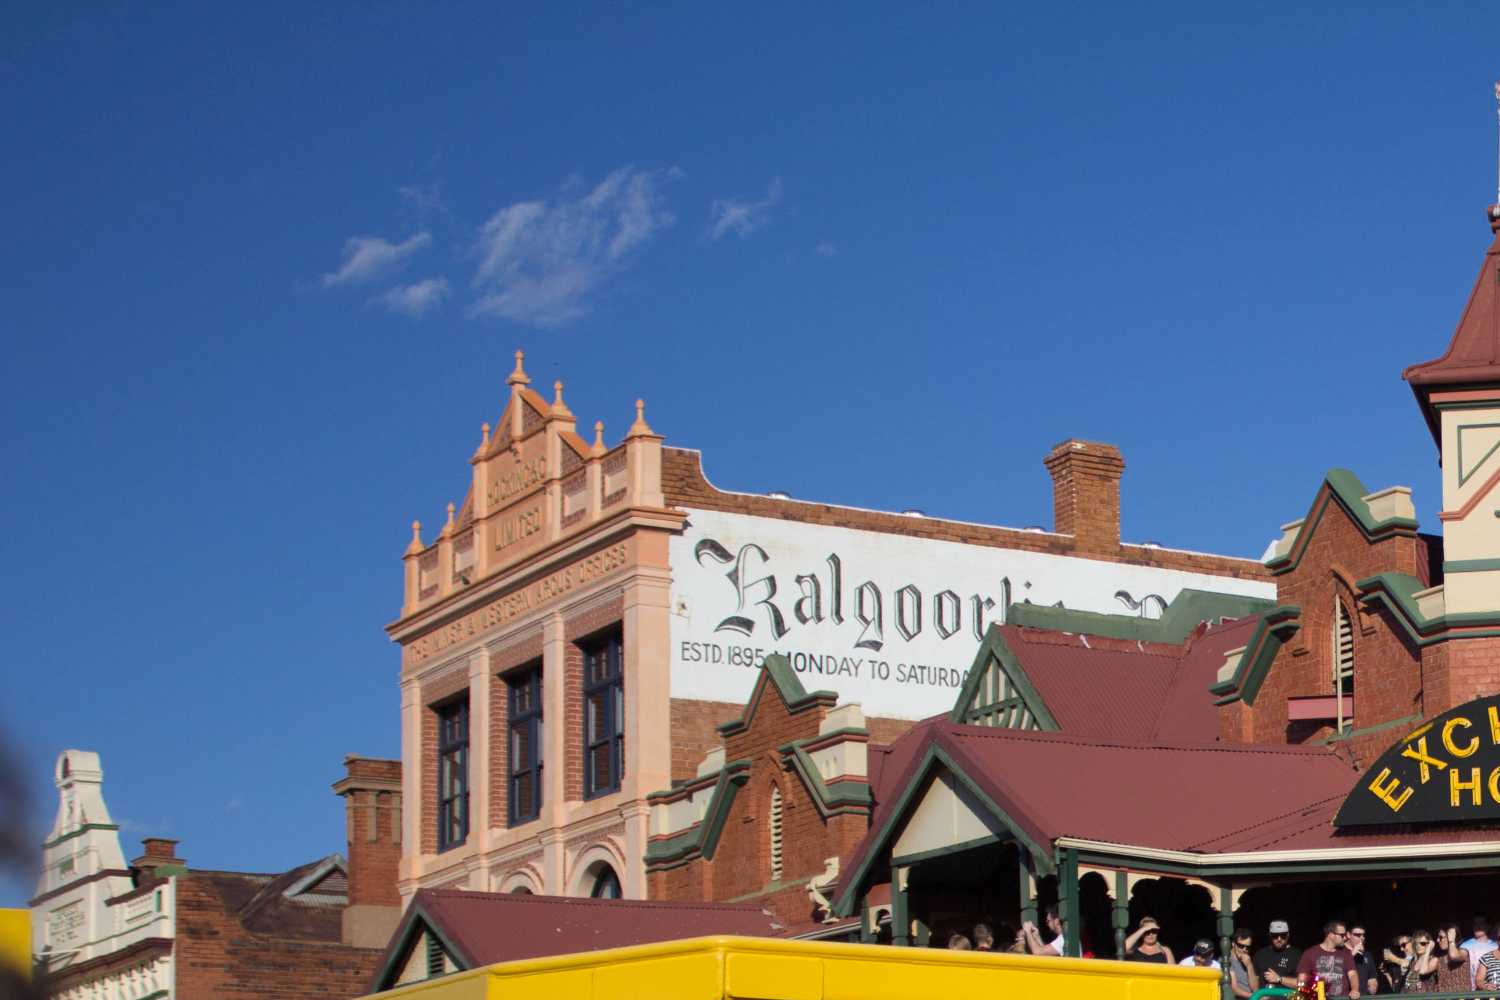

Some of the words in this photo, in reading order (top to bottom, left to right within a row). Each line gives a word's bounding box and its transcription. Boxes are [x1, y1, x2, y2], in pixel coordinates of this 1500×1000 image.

[694, 538, 1064, 652] Kalgoorl
[774, 650, 863, 678] ONDAY
[869, 660, 890, 680] TO
[896, 663, 970, 688] SATURDA
